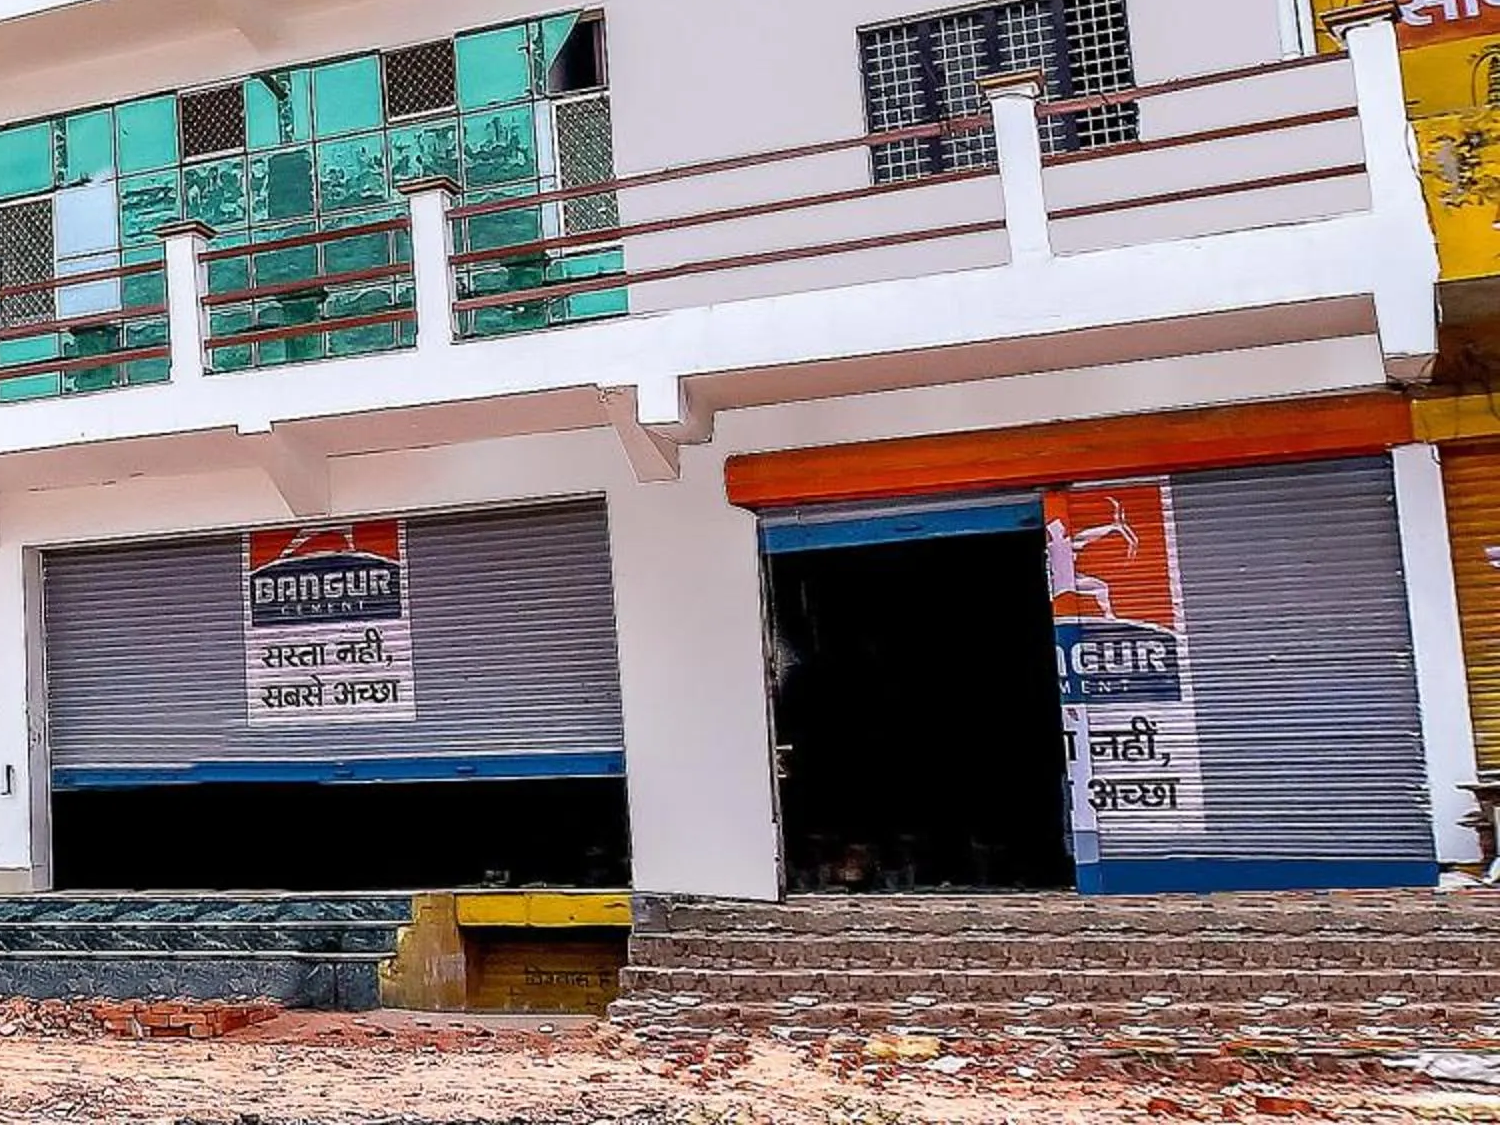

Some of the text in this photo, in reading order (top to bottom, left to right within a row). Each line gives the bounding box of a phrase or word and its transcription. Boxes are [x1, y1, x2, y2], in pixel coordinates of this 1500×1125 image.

[254, 569, 391, 604] BANGUR
[261, 643, 327, 668] सस्ता
[1056, 641, 1168, 676] GUR
[261, 675, 401, 708] सबसे अच्छा
[1060, 679, 1130, 694] MENT
[1088, 777, 1180, 810] अच्छा
